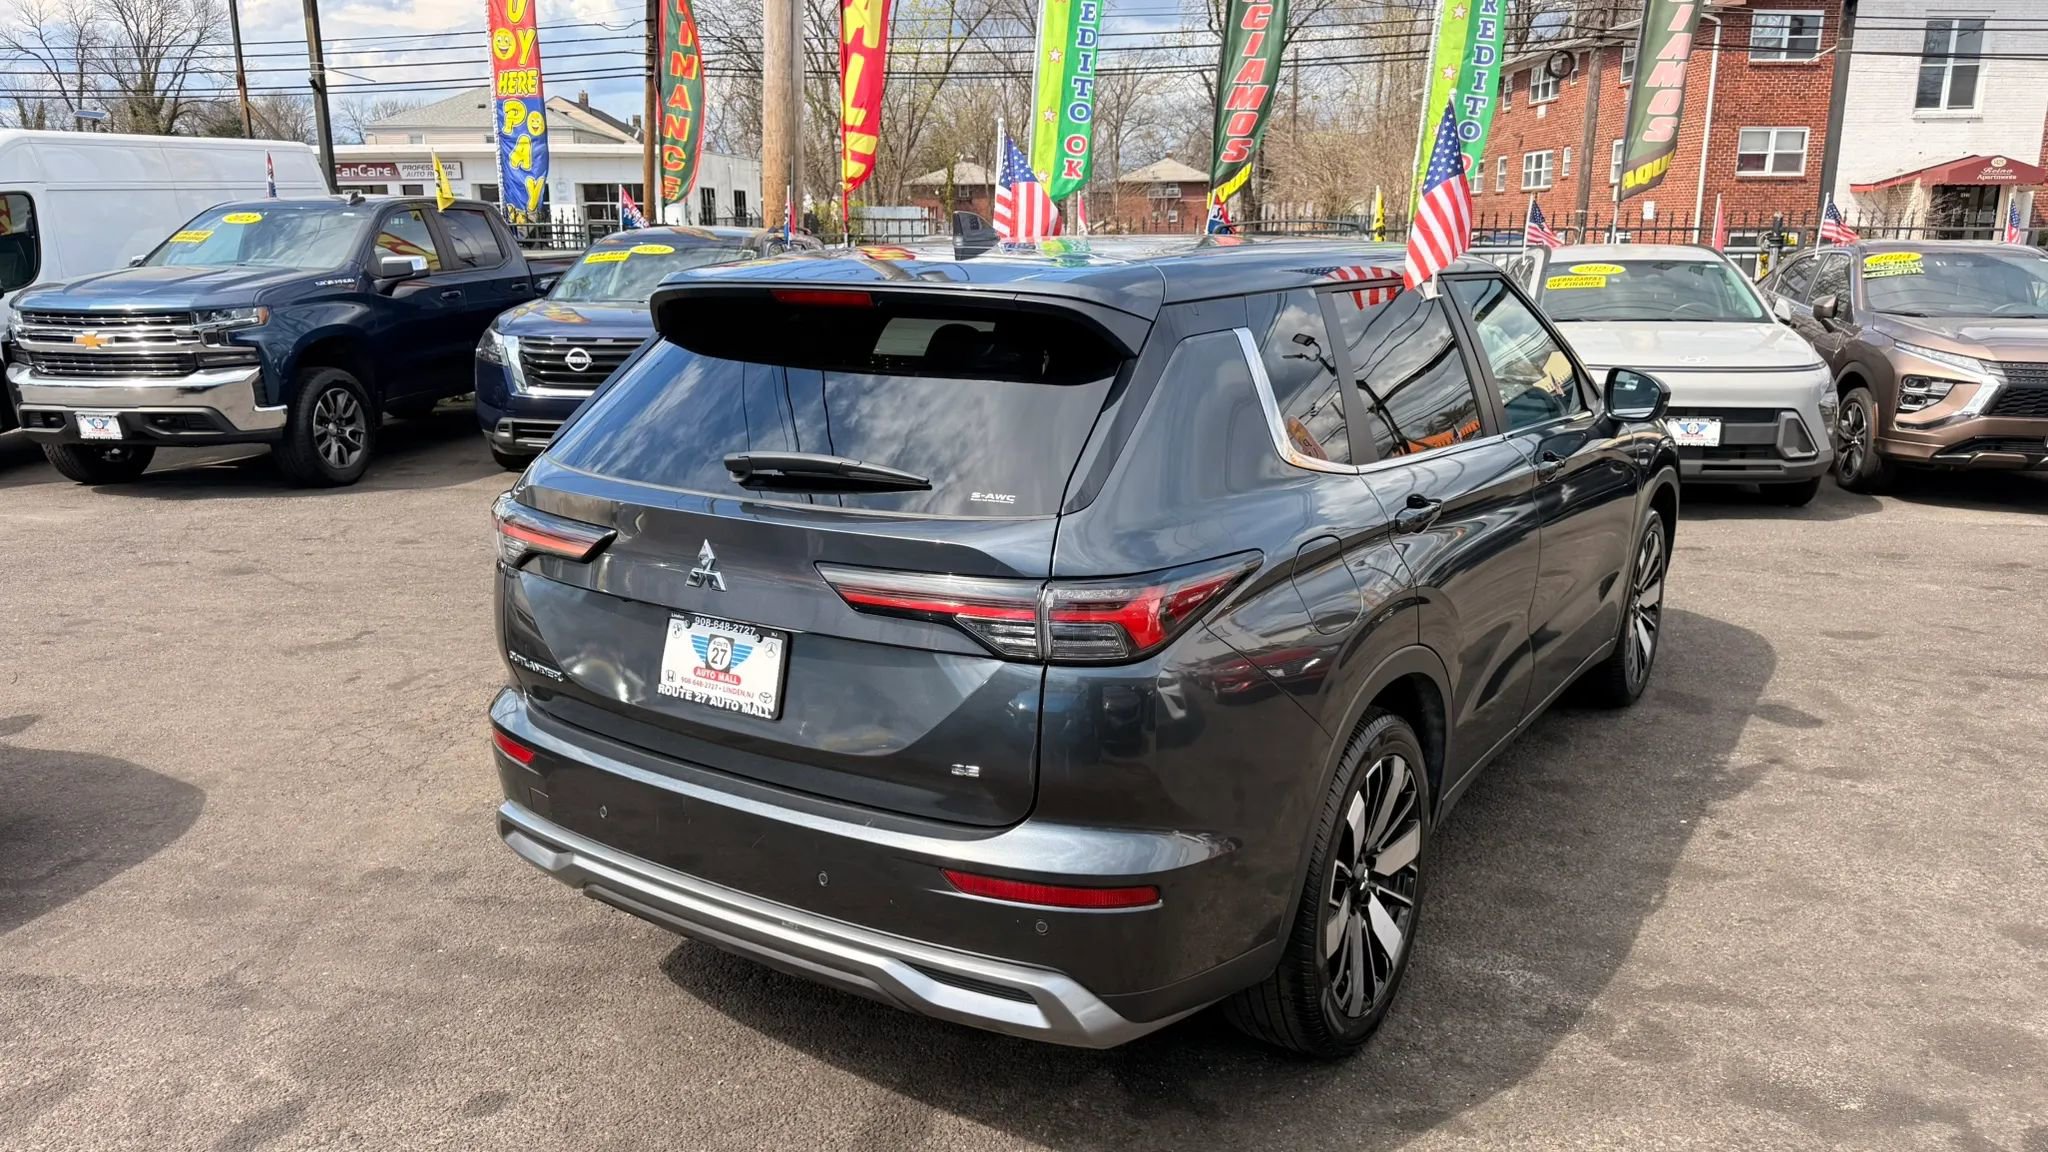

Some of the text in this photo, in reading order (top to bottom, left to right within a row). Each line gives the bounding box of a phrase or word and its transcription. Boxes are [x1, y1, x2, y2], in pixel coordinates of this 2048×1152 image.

[498, 69, 539, 96] HERE
[1220, 0, 1273, 163] CIAMOS
[1642, 0, 1695, 143] IAMOS
[662, 0, 699, 201] INANCE
[503, 100, 545, 213] PAY
[1064, 133, 1088, 180] OK
[971, 491, 1016, 502] S-AWC
[694, 616, 756, 636] 908-648-2727
[711, 647, 728, 665] 27
[696, 668, 739, 684] AUTO MALL
[657, 683, 772, 719] ROUTE 27 AUTO MALL
